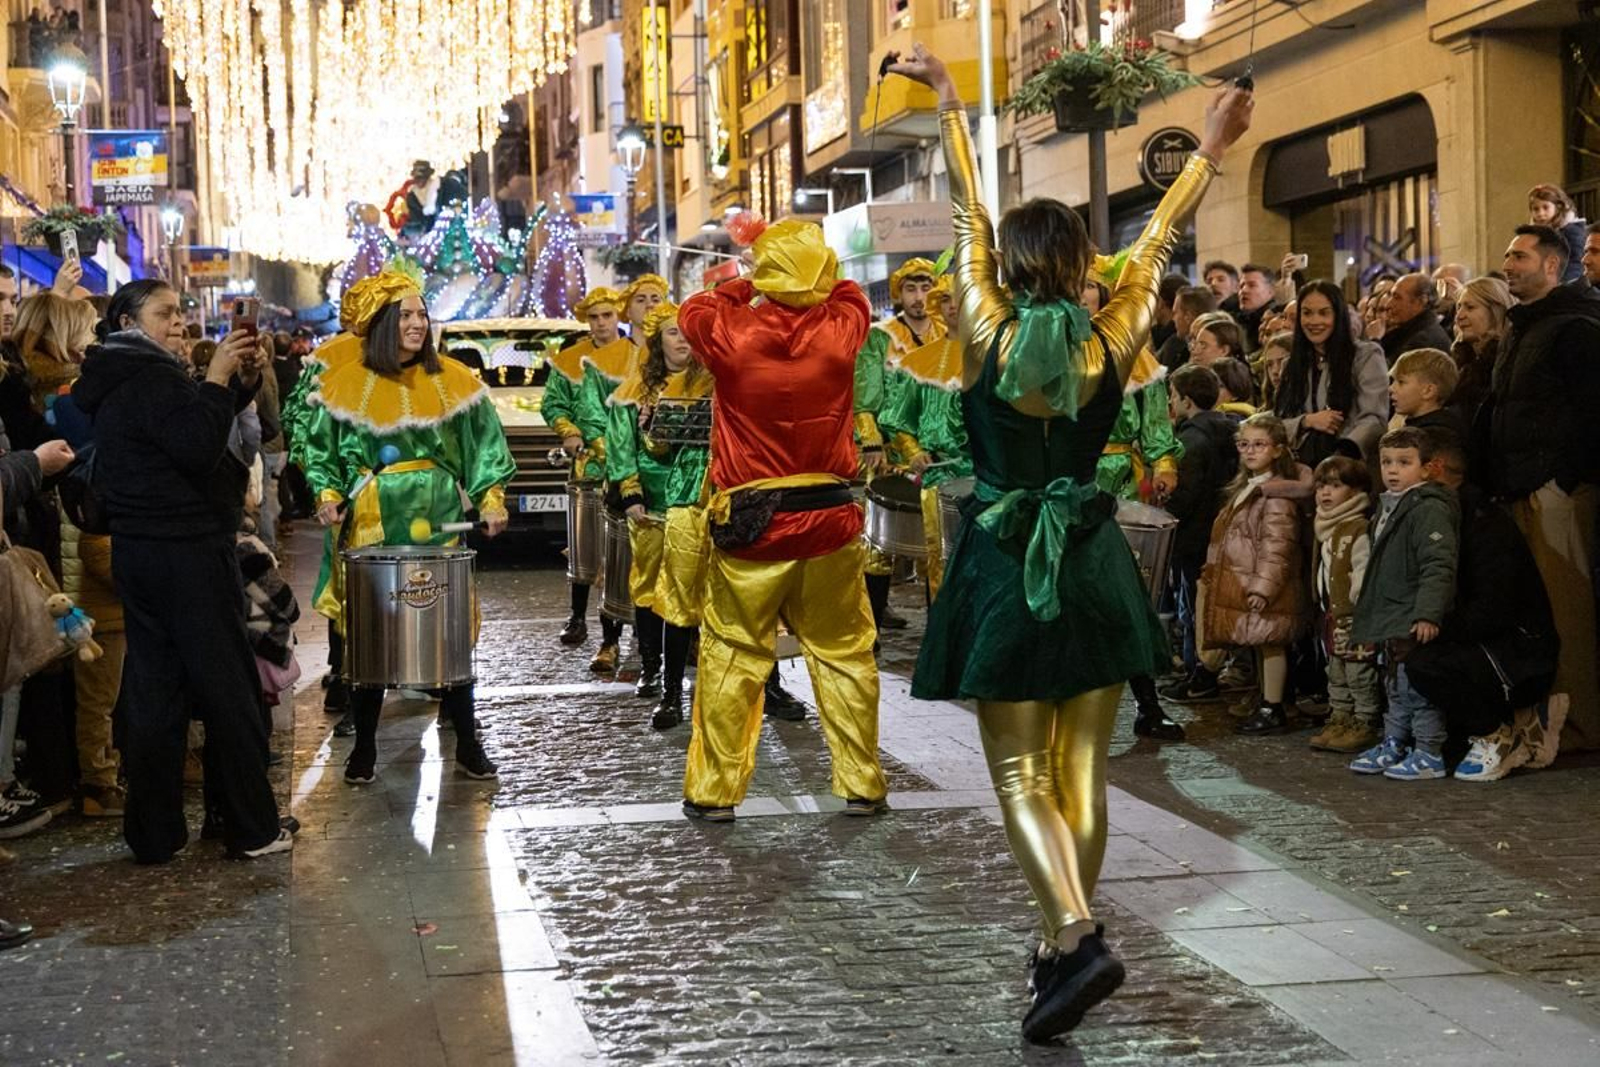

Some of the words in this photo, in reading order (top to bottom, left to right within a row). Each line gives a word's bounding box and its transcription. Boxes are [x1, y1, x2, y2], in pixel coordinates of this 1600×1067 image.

[1153, 150, 1190, 174] SIBUY
[104, 185, 153, 193] DACIA
[105, 193, 154, 203] JAPEMASA
[531, 496, 564, 510] 2741
